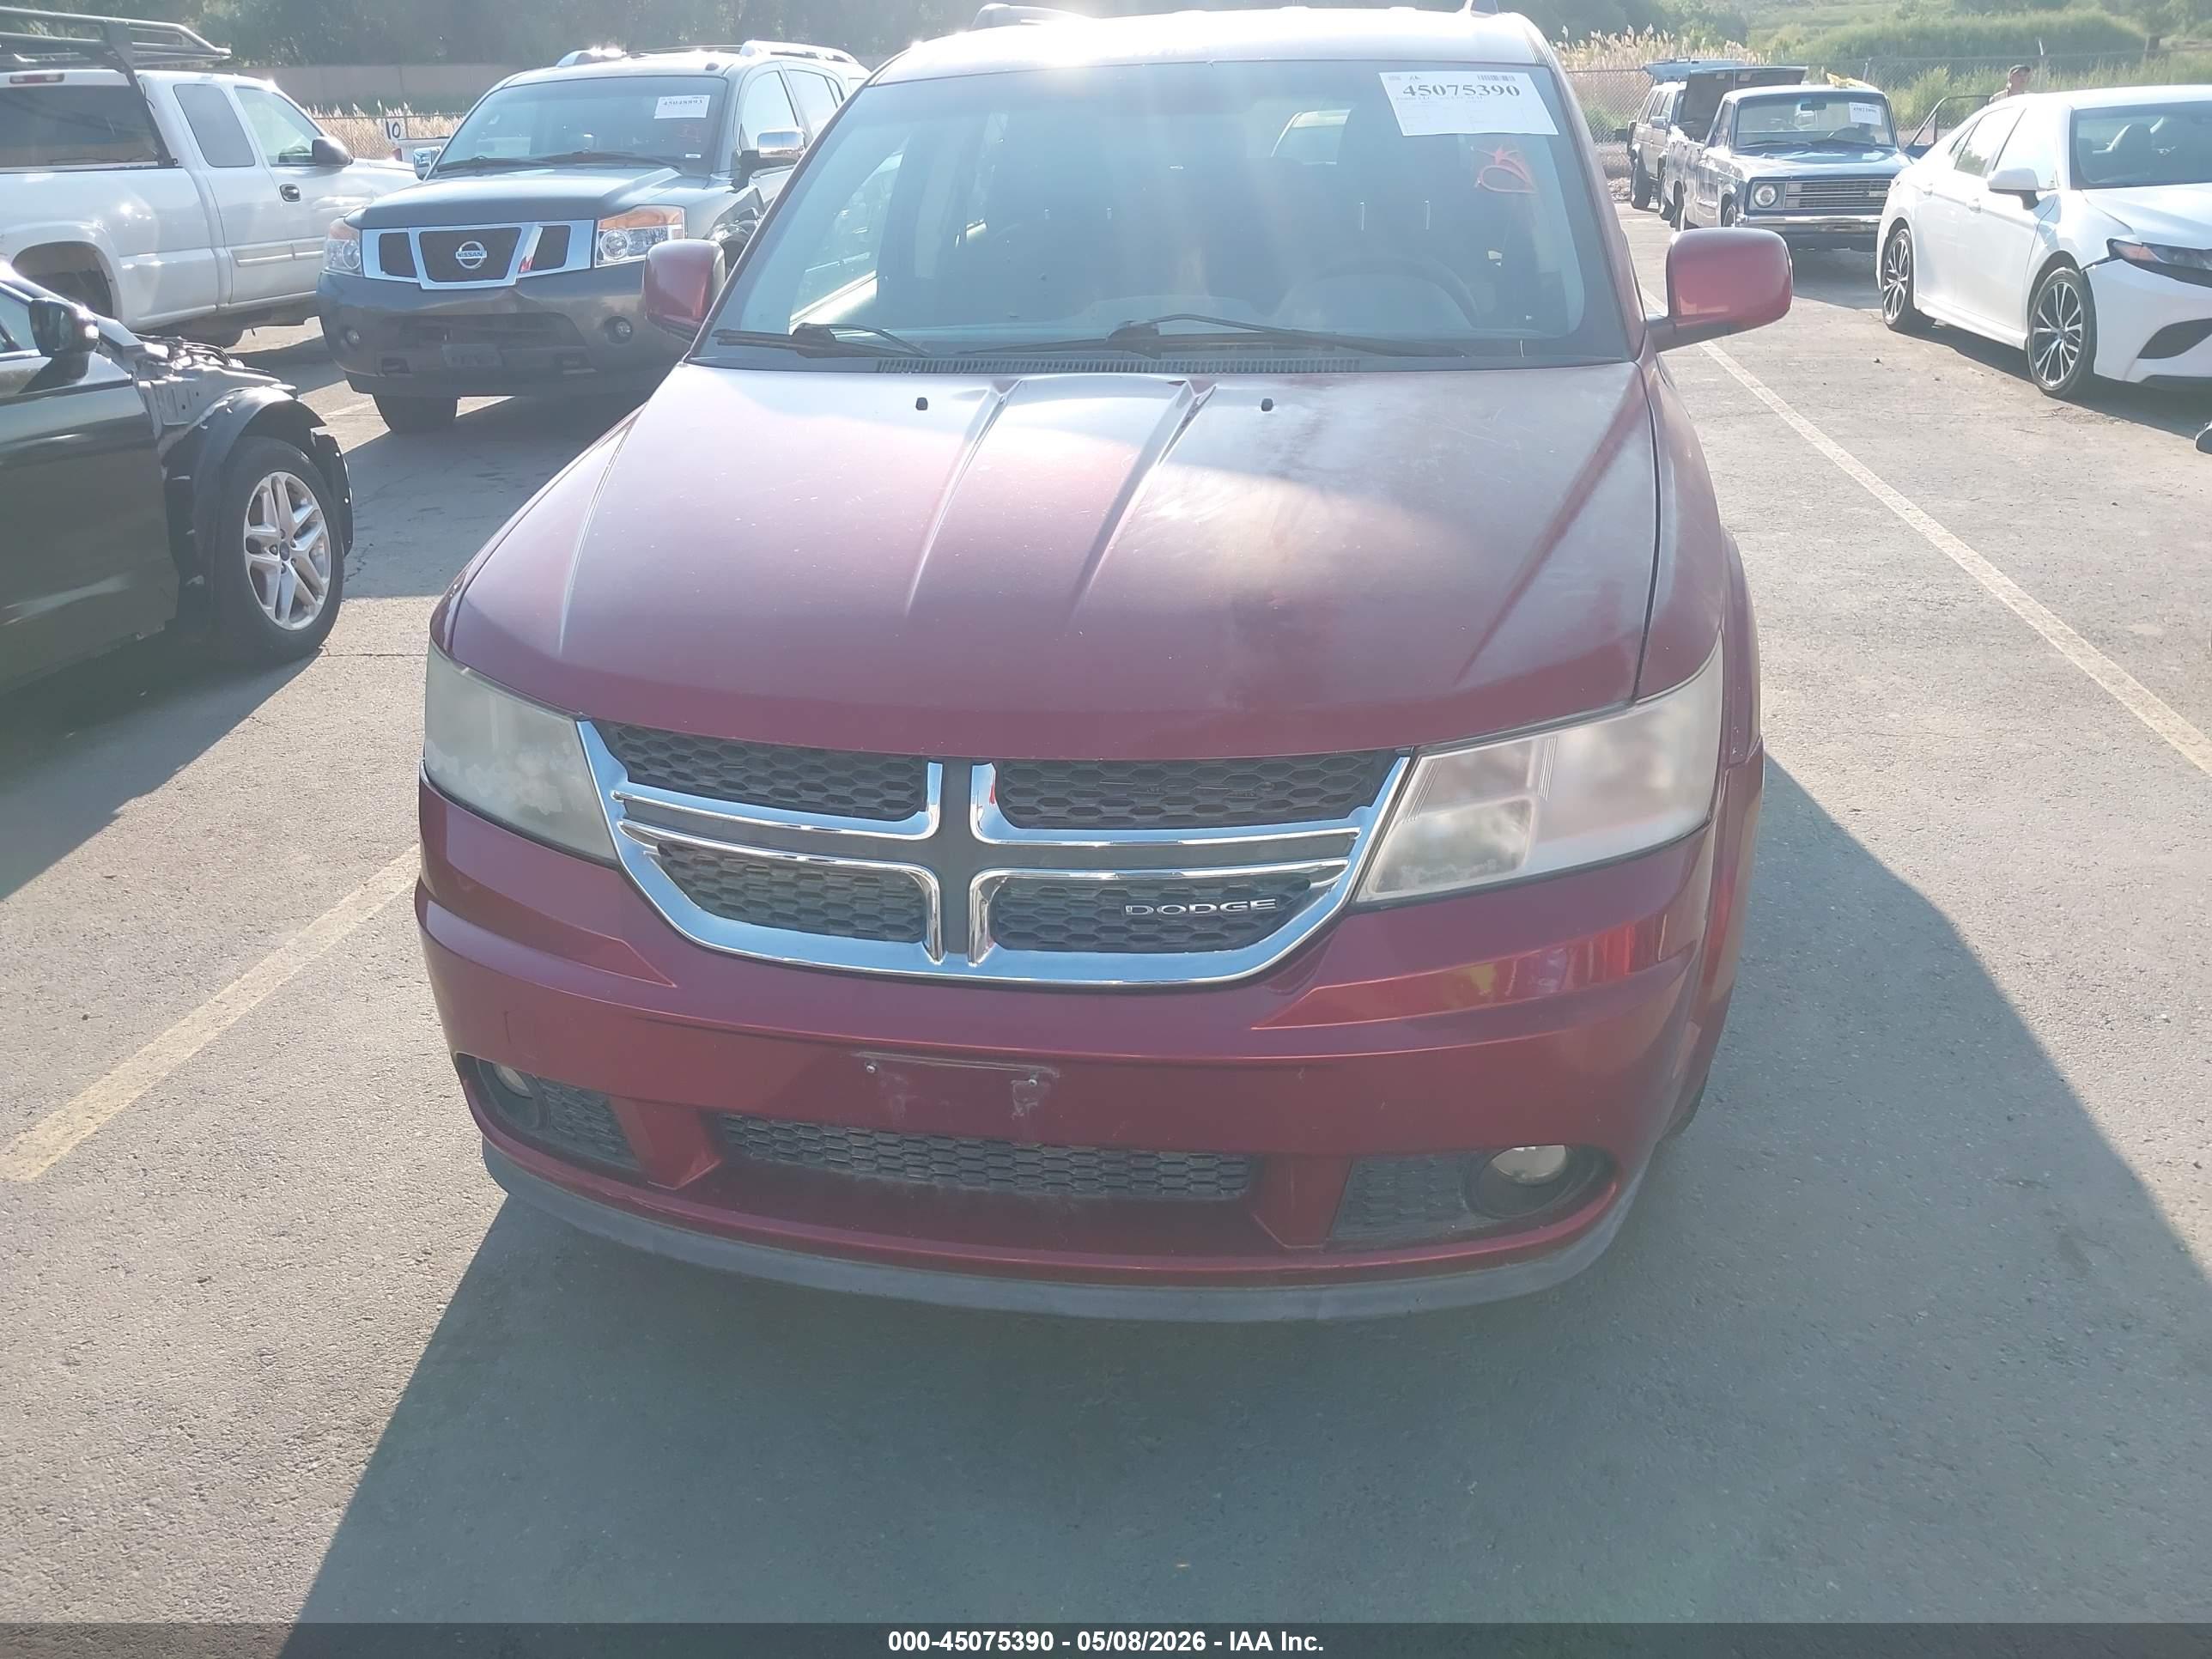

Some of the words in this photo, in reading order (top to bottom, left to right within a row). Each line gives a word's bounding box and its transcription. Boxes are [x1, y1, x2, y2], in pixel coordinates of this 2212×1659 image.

[1402, 84, 1520, 96] 45075390
[386, 121, 401, 139] 10
[1126, 898, 1277, 915] DODGE
